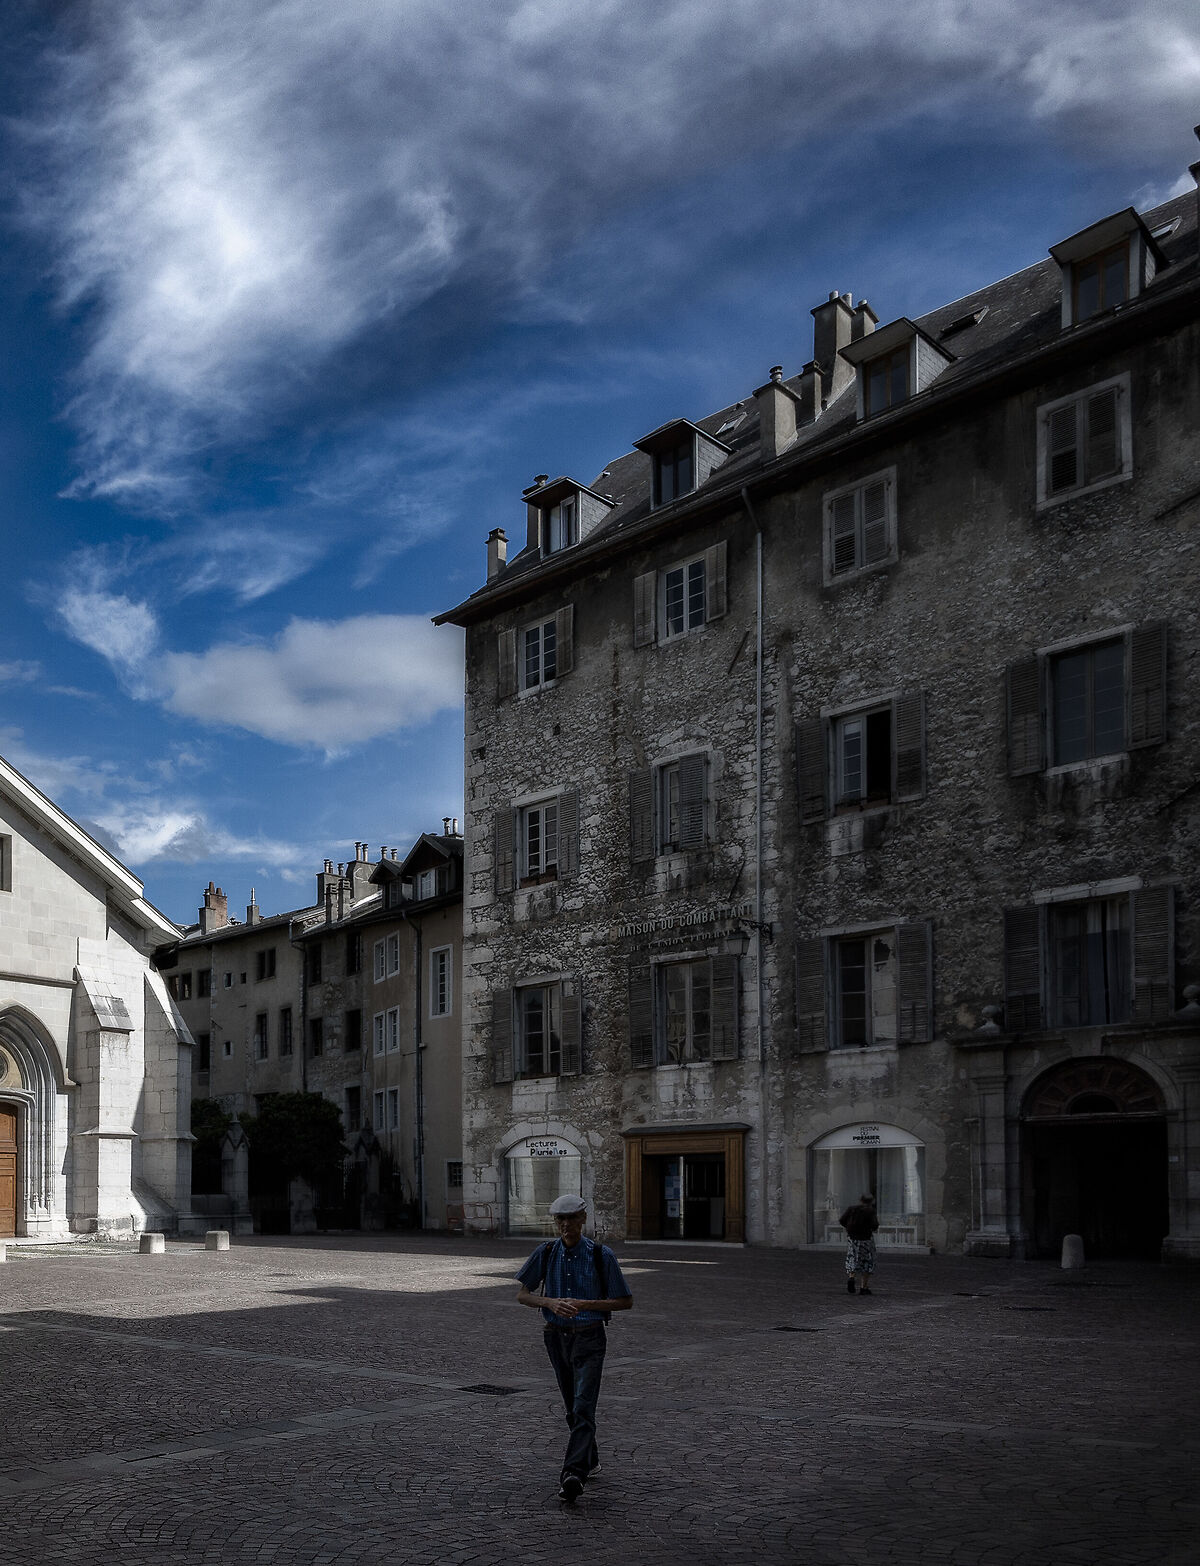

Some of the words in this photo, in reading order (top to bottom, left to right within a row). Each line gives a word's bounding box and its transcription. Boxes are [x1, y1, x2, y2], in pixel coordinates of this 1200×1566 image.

[618, 922, 656, 937] MAISON
[661, 918, 674, 930] DU
[525, 1140, 557, 1148] Lectures
